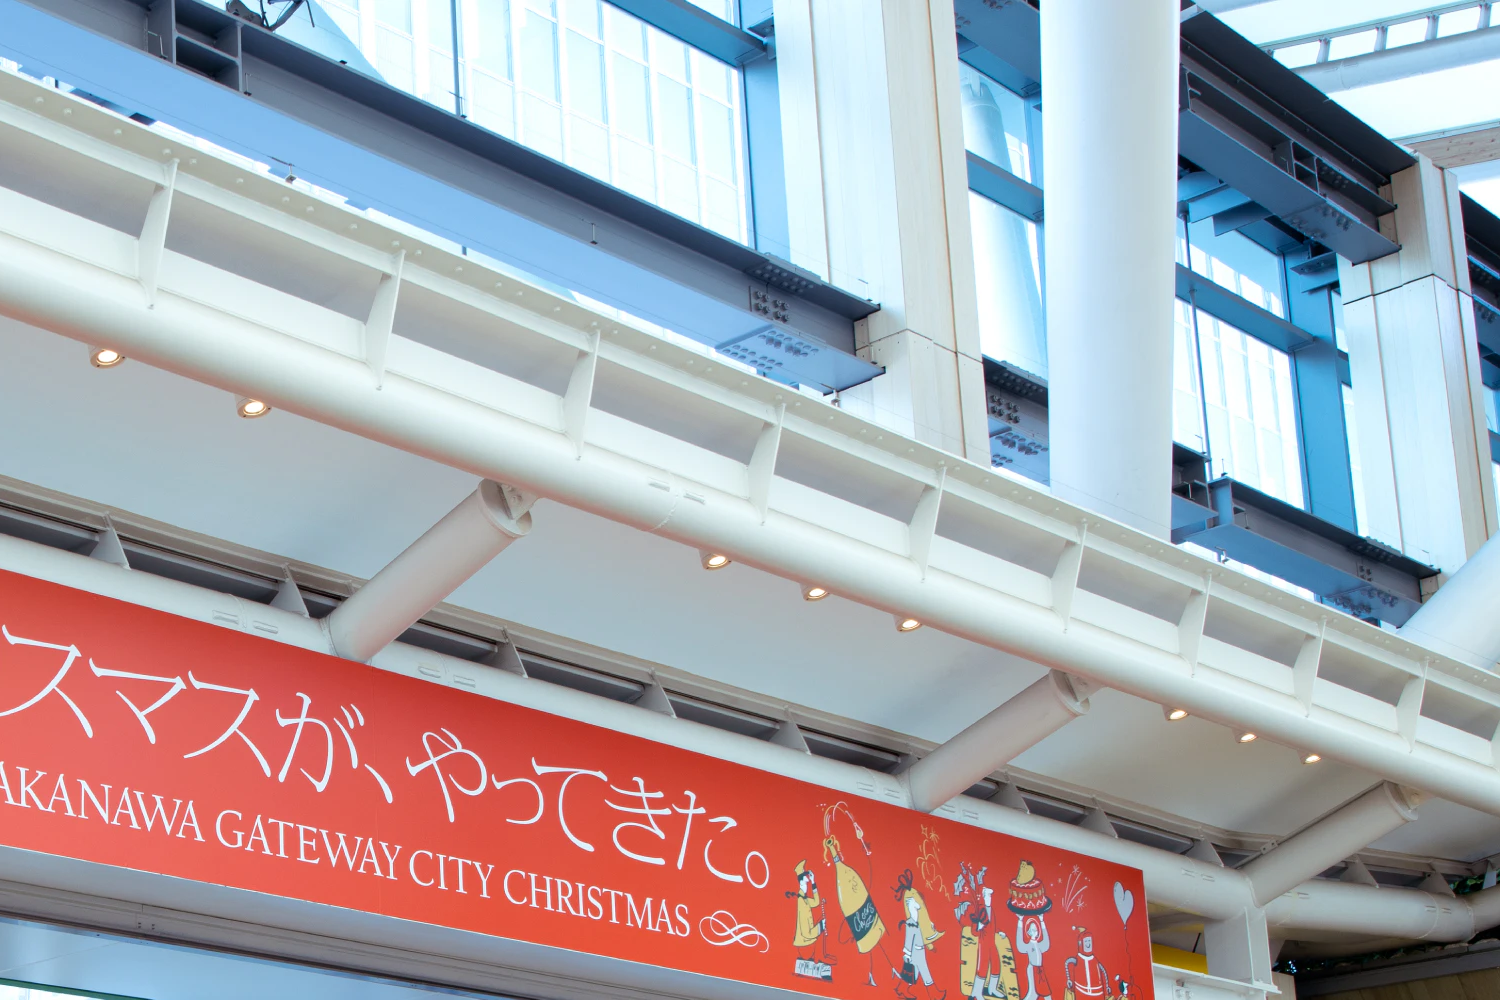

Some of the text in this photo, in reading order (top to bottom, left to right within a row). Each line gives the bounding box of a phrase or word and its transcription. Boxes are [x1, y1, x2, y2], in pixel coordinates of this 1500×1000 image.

[215, 809, 402, 881] GATEWAY
[408, 849, 495, 899] CITY
[503, 869, 691, 937] CHRISTMAS
